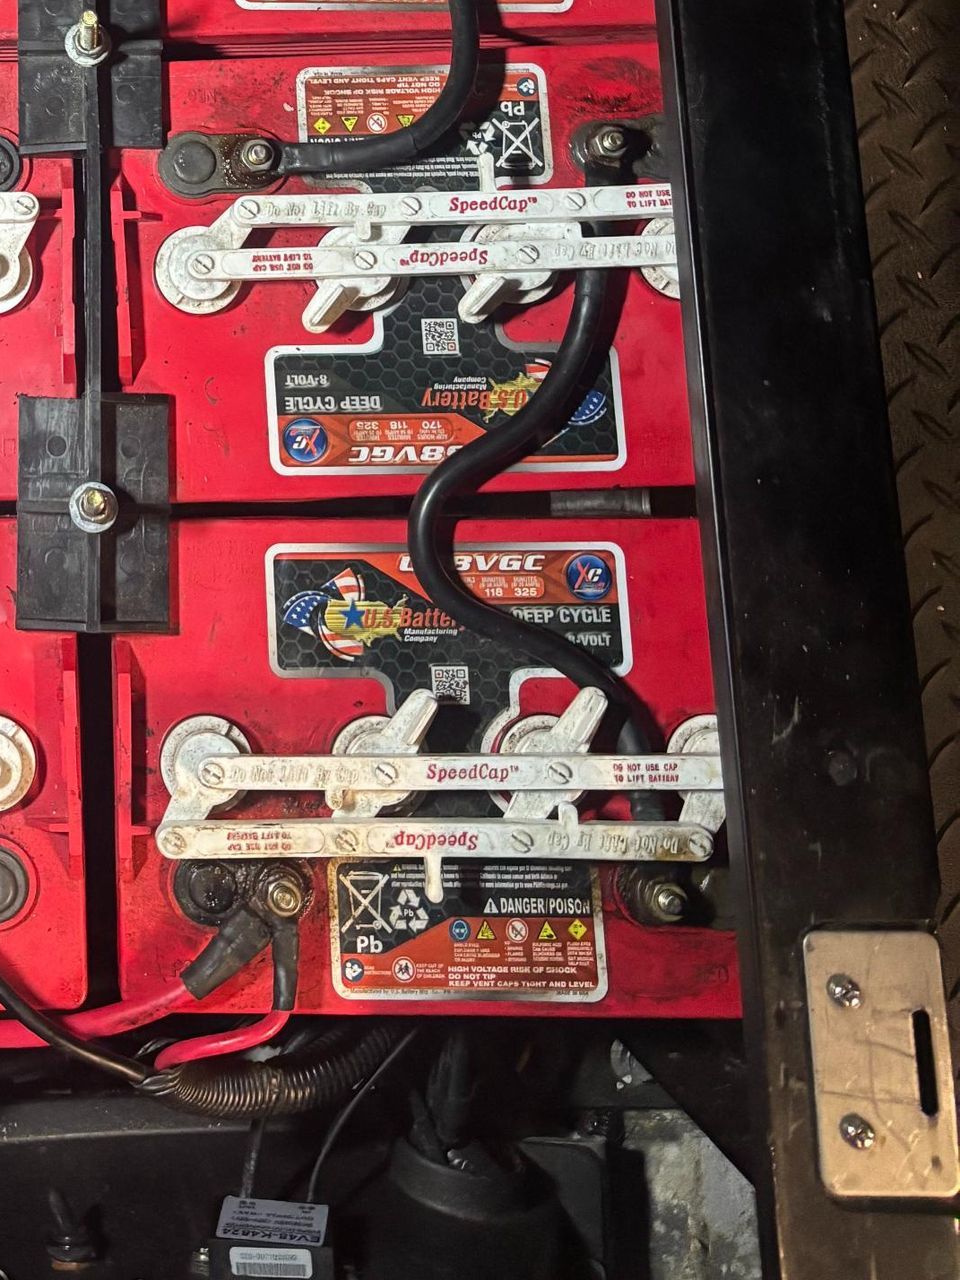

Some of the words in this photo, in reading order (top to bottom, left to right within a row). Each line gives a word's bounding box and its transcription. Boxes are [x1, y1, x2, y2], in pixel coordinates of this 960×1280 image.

[500, 101, 526, 116] Pb
[656, 189, 671, 197] USE
[253, 264, 267, 272] CAP
[285, 374, 328, 386] 8-VOLT
[453, 375, 487, 384] Company
[433, 382, 487, 390] Manufacturing
[285, 396, 335, 410] CYCLE
[340, 396, 381, 410] DEEP
[421, 388, 490, 410] Battery
[356, 421, 379, 430] 325
[389, 420, 408, 429] 118
[422, 420, 442, 429] 170
[347, 445, 463, 463] 8VGC
[398, 554, 545, 572] U8VGC
[484, 587, 503, 597] 118
[514, 587, 537, 596] 325
[400, 607, 457, 628] Batte
[559, 608, 611, 623] CYCLE
[403, 627, 458, 637] Manufacturing
[403, 635, 438, 643] Company
[499, 897, 591, 915] DANGER/POISON
[403, 909, 414, 918] Pb
[356, 936, 383, 954] Pb
[447, 966, 469, 974] HIGH
[471, 966, 508, 974] VOLTAGE
